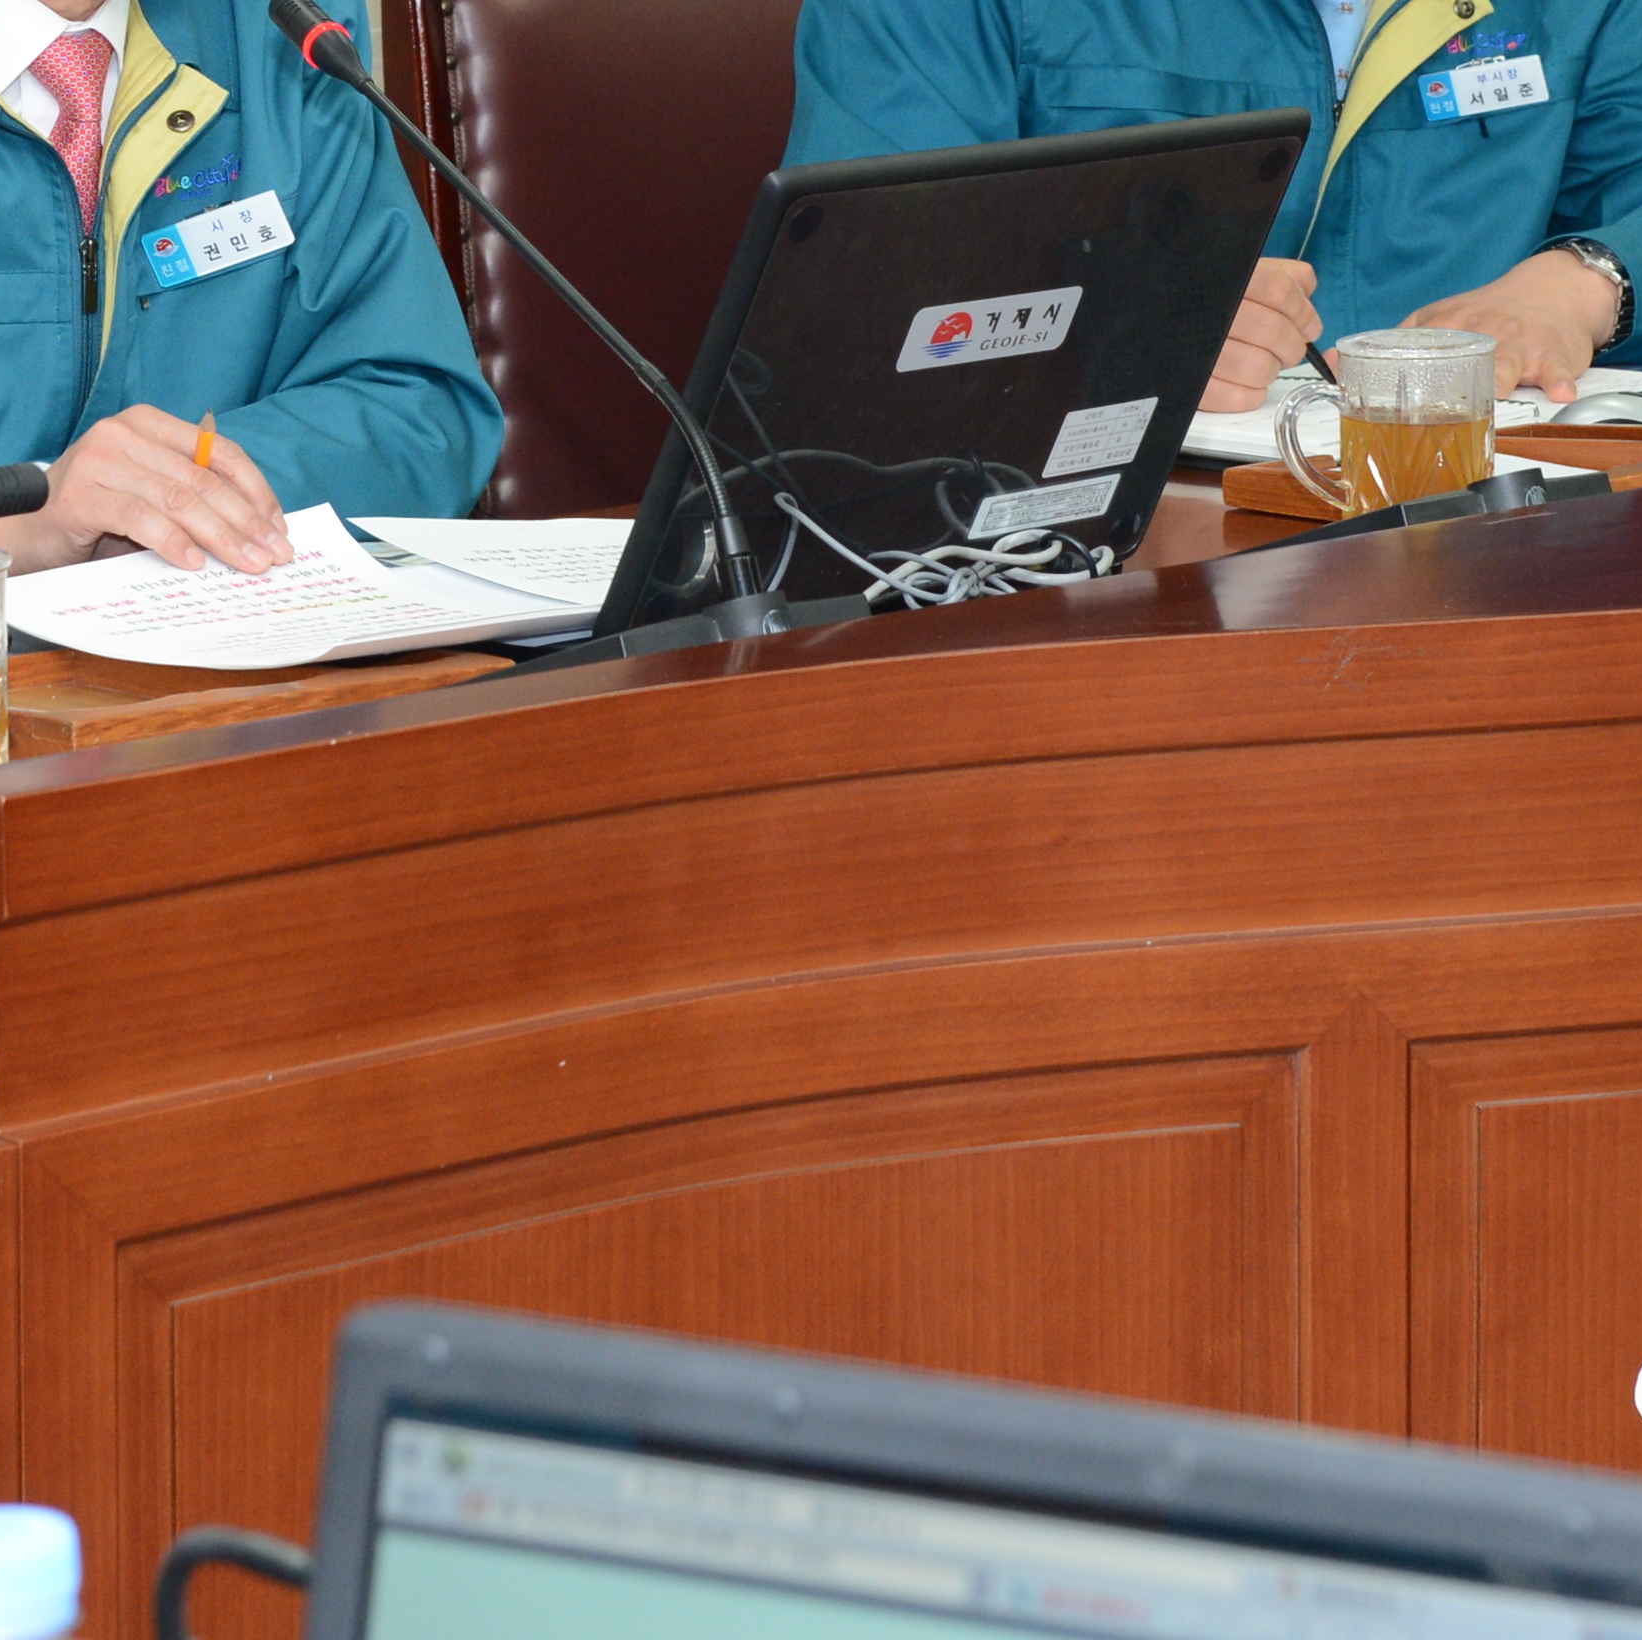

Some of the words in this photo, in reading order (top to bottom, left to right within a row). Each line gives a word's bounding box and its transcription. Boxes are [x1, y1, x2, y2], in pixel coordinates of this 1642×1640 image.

[1477, 68, 1518, 84] 부시장
[1471, 83, 1534, 105] 서일준
[154, 174, 192, 198] Blue
[193, 167, 231, 187] City
[212, 209, 253, 232] 시장
[203, 225, 277, 261] 권민호
[160, 258, 190, 278] 친절
[986, 302, 1063, 334] 거제시
[980, 331, 1048, 351] GEOJE-SI
